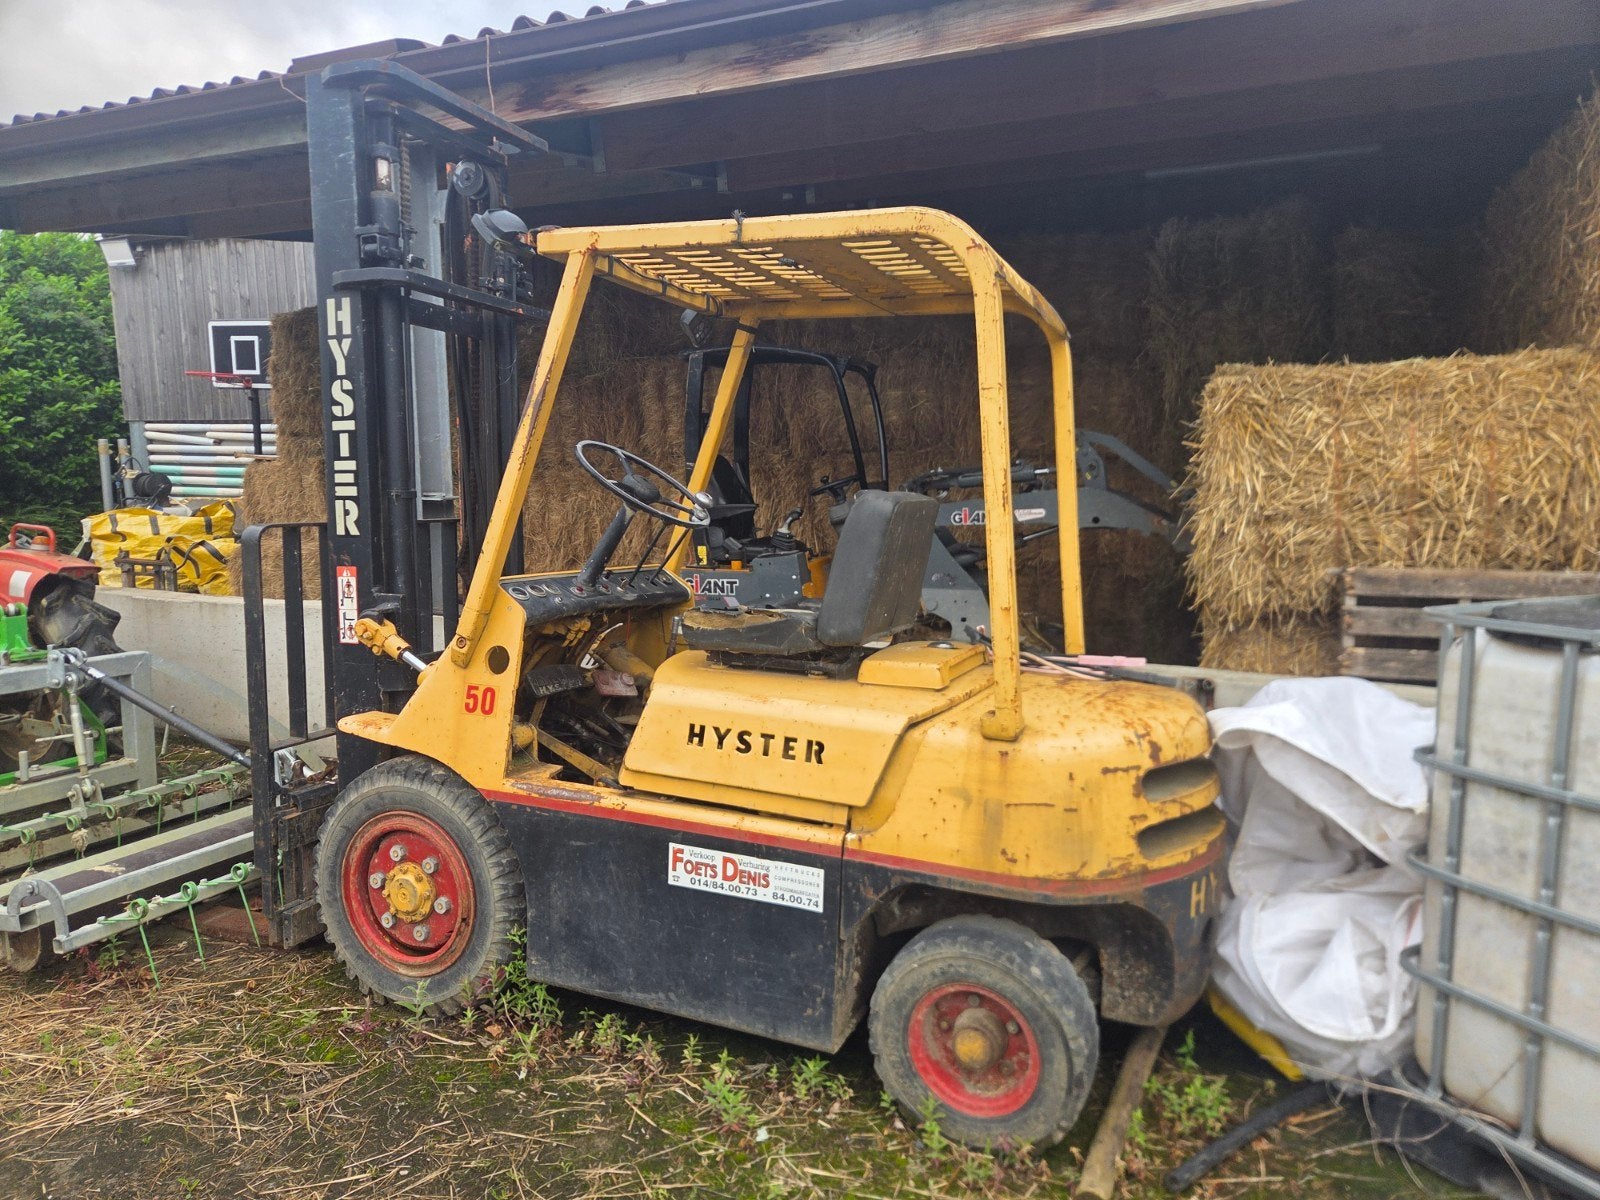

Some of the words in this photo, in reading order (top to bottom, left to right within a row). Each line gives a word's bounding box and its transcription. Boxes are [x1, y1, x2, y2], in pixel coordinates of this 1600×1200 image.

[327, 297, 360, 536] HYSTER
[464, 684, 496, 715] 50
[686, 723, 825, 765] HYSTER
[672, 846, 718, 879] FOETS
[722, 856, 770, 889] DENIS
[689, 848, 716, 862] Verkoop
[738, 858, 771, 872] Verhuring
[690, 877, 758, 896] 014/84.00.73
[772, 892, 819, 908] 84.00.74
